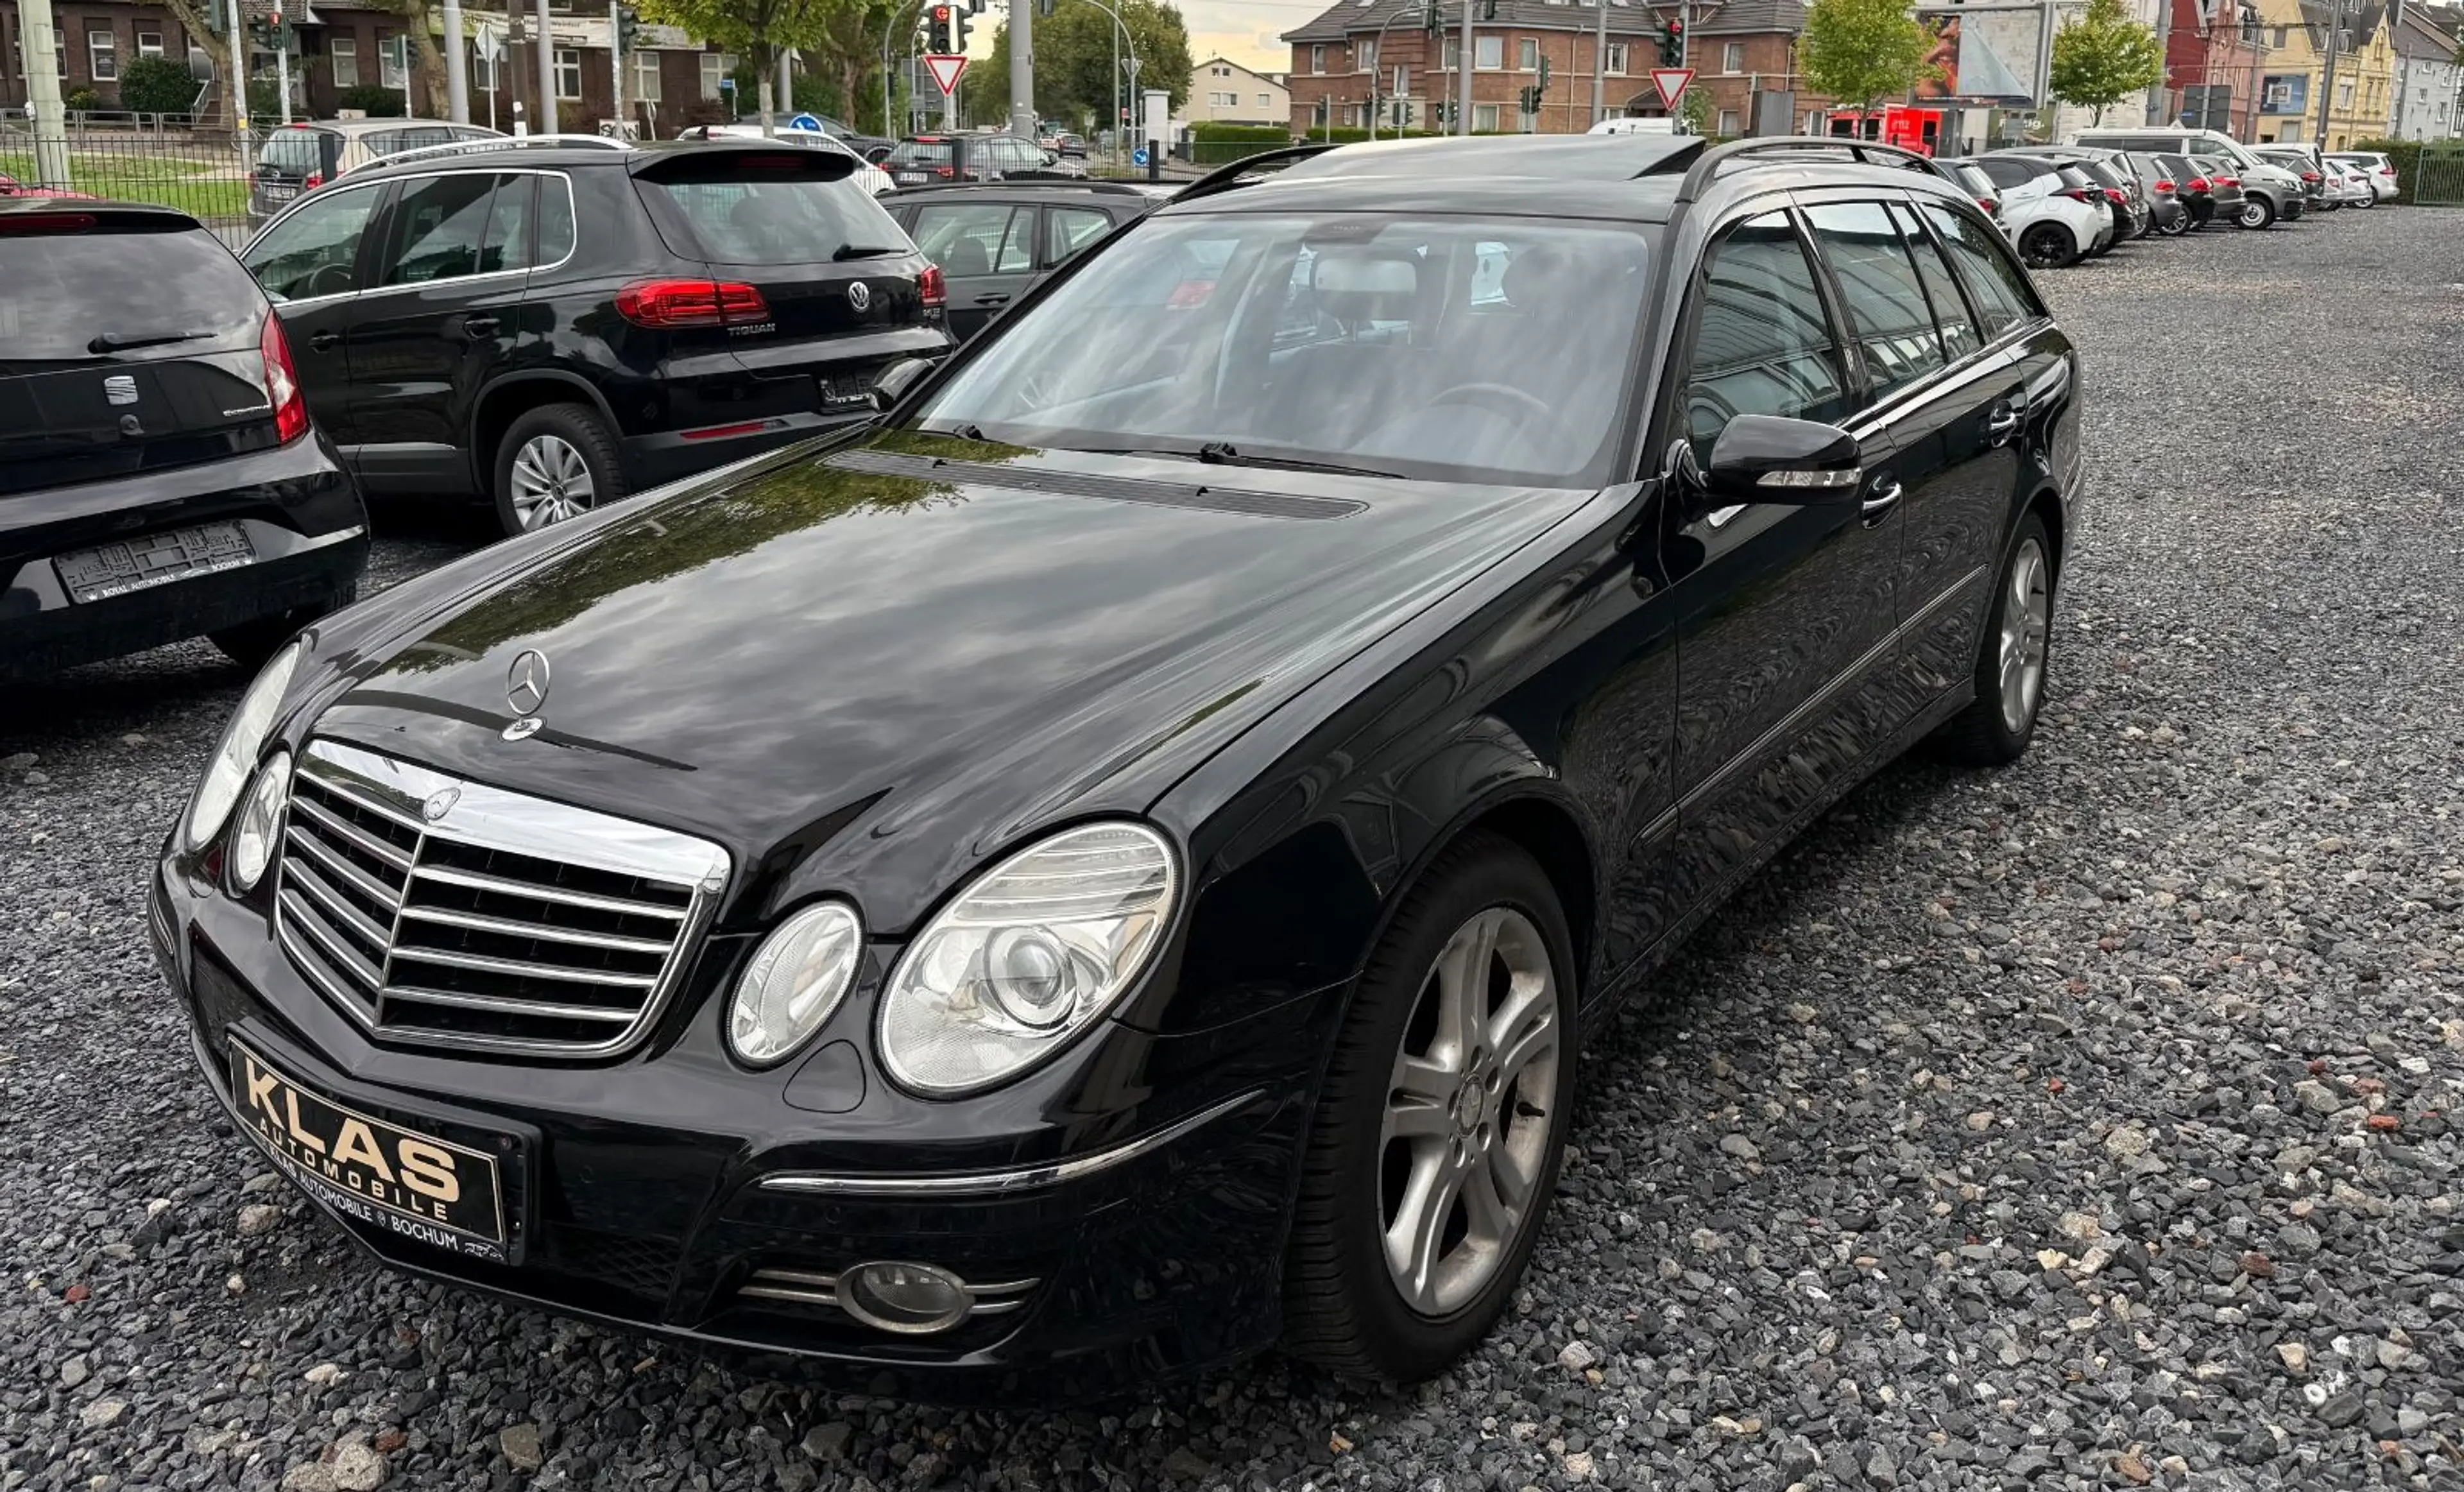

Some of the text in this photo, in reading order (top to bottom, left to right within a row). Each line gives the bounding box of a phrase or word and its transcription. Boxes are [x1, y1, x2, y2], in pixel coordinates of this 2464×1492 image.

[102, 585, 130, 597] ROYAL
[245, 1058, 460, 1203] KLAS
[259, 1117, 448, 1221] AUTOMOBILE
[300, 1170, 373, 1223] AUTOMOBILE
[391, 1214, 459, 1250] BOCHUM
